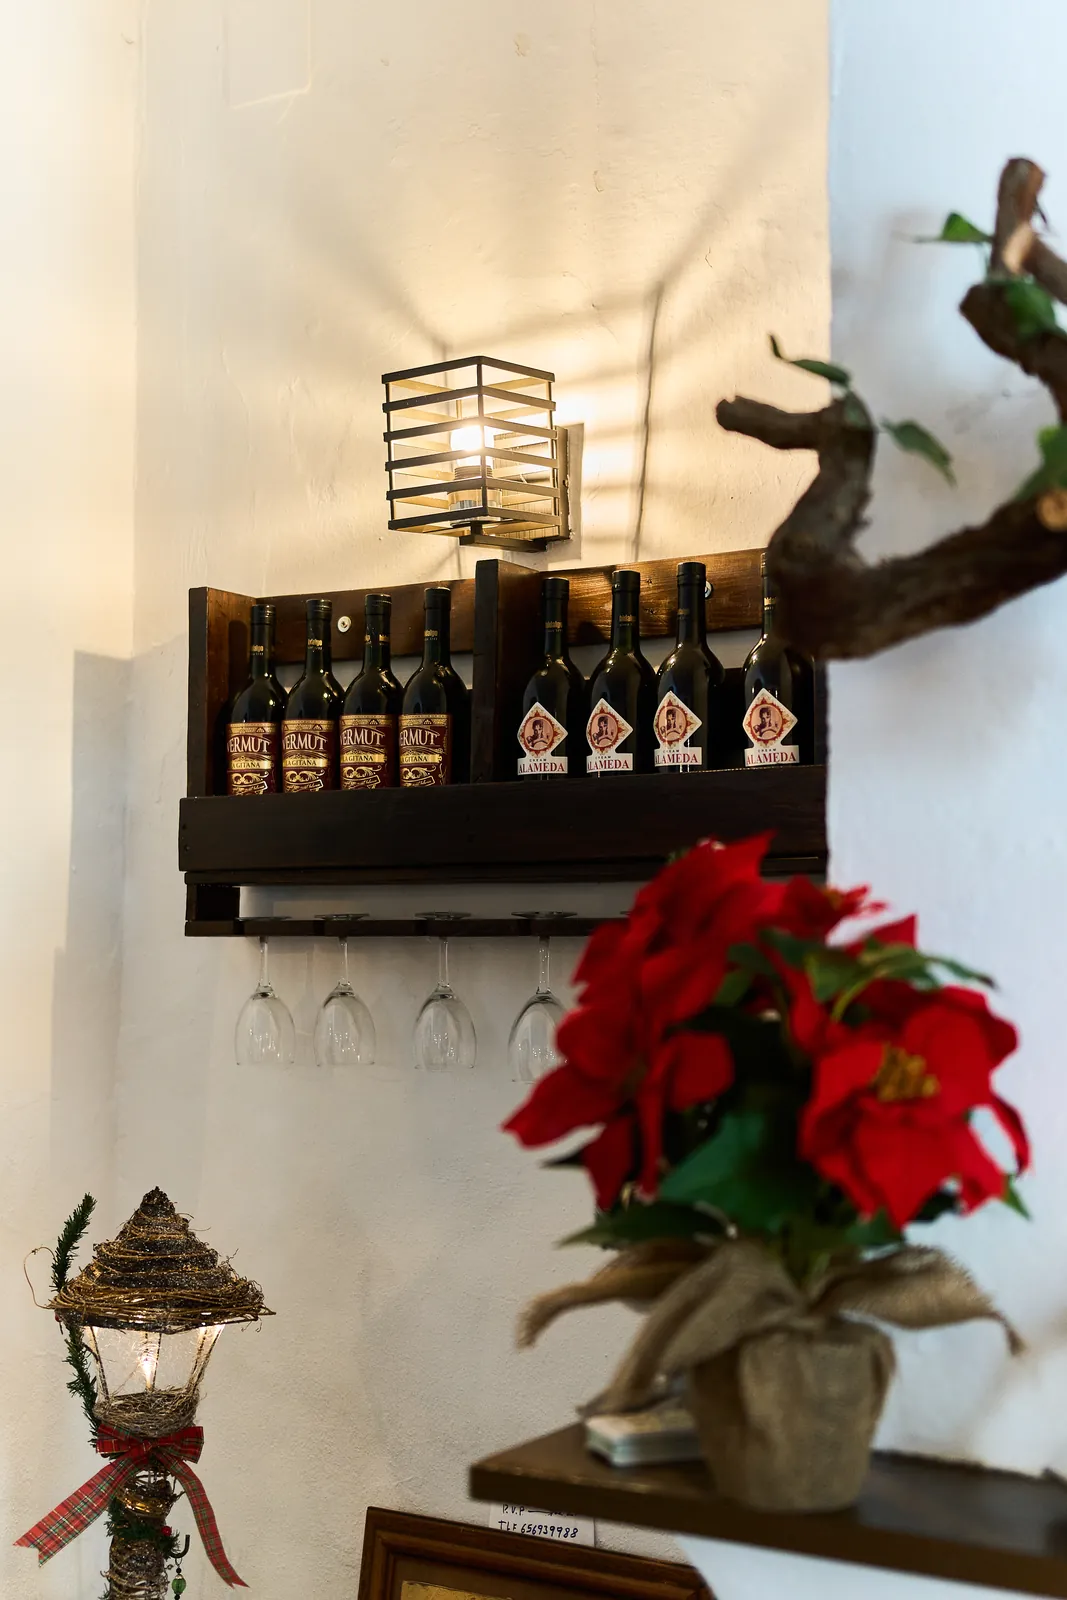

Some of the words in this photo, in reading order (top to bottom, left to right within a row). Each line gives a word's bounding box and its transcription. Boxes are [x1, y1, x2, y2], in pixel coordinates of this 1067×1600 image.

[746, 751, 796, 765] ALAMEDA
[519, 762, 565, 773] ALAMEDA
[498, 1520, 518, 1532] TLF
[520, 1523, 579, 1539] 656939988
